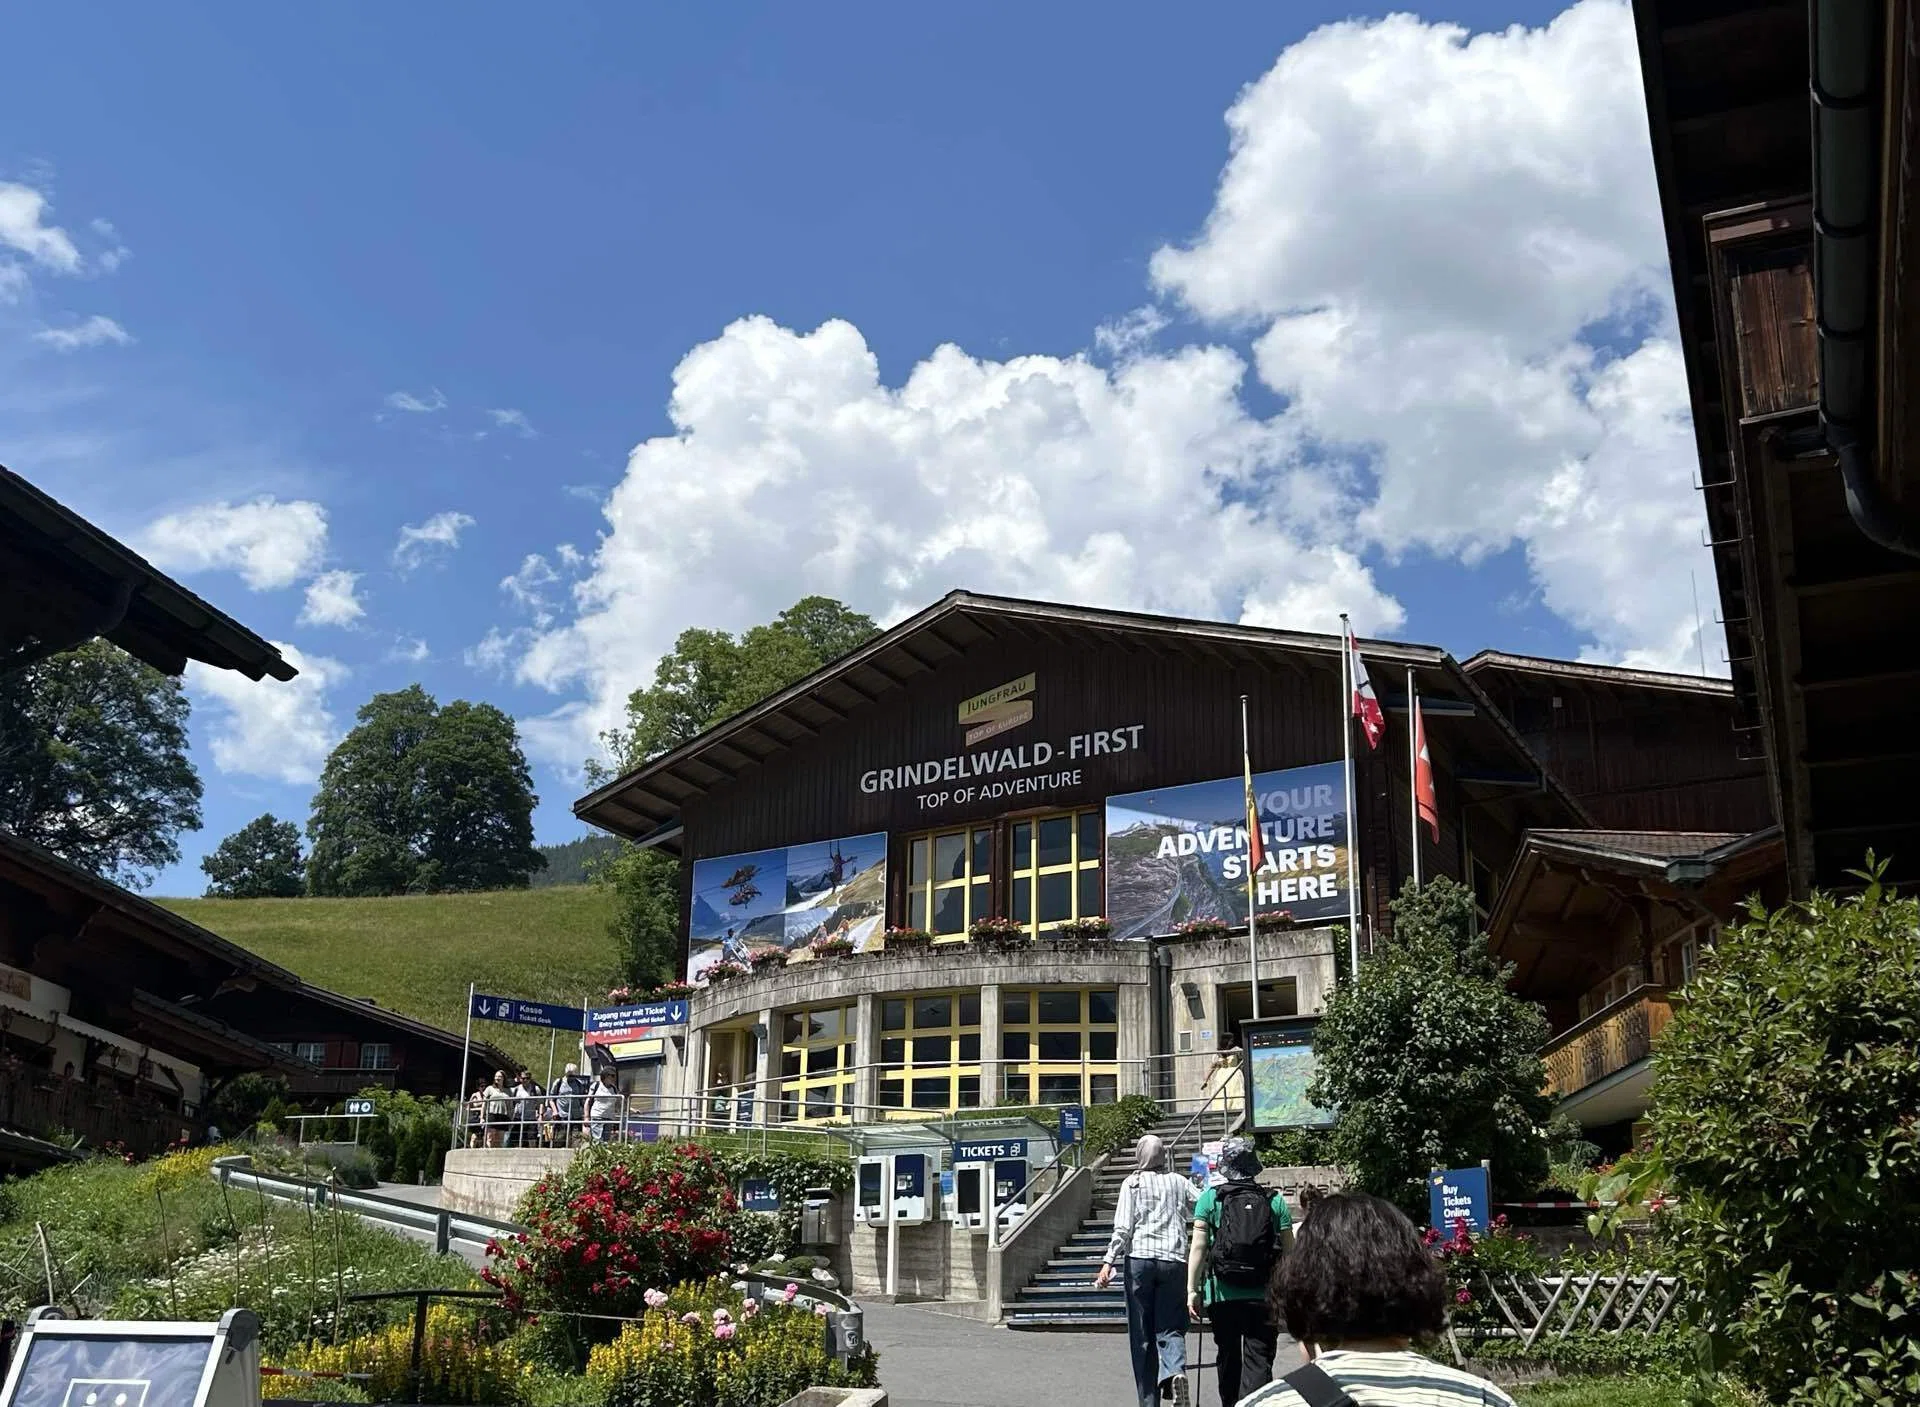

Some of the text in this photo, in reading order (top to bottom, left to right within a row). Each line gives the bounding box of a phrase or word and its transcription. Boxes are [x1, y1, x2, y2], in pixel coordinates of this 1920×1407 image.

[967, 680, 1026, 715] JUNGFRAU
[917, 769, 1082, 810] TOP OF ADVENTURE
[1256, 784, 1333, 816] YOUR
[1156, 813, 1335, 860] ADVENTURE
[1257, 873, 1338, 905] HERE
[593, 1006, 666, 1021] Zugang nur mit Ticket
[961, 1145, 1005, 1158] TICKETS
[1442, 1185, 1458, 1195] Buy
[1442, 1196, 1472, 1207] Tickets
[1443, 1208, 1471, 1218] Online
